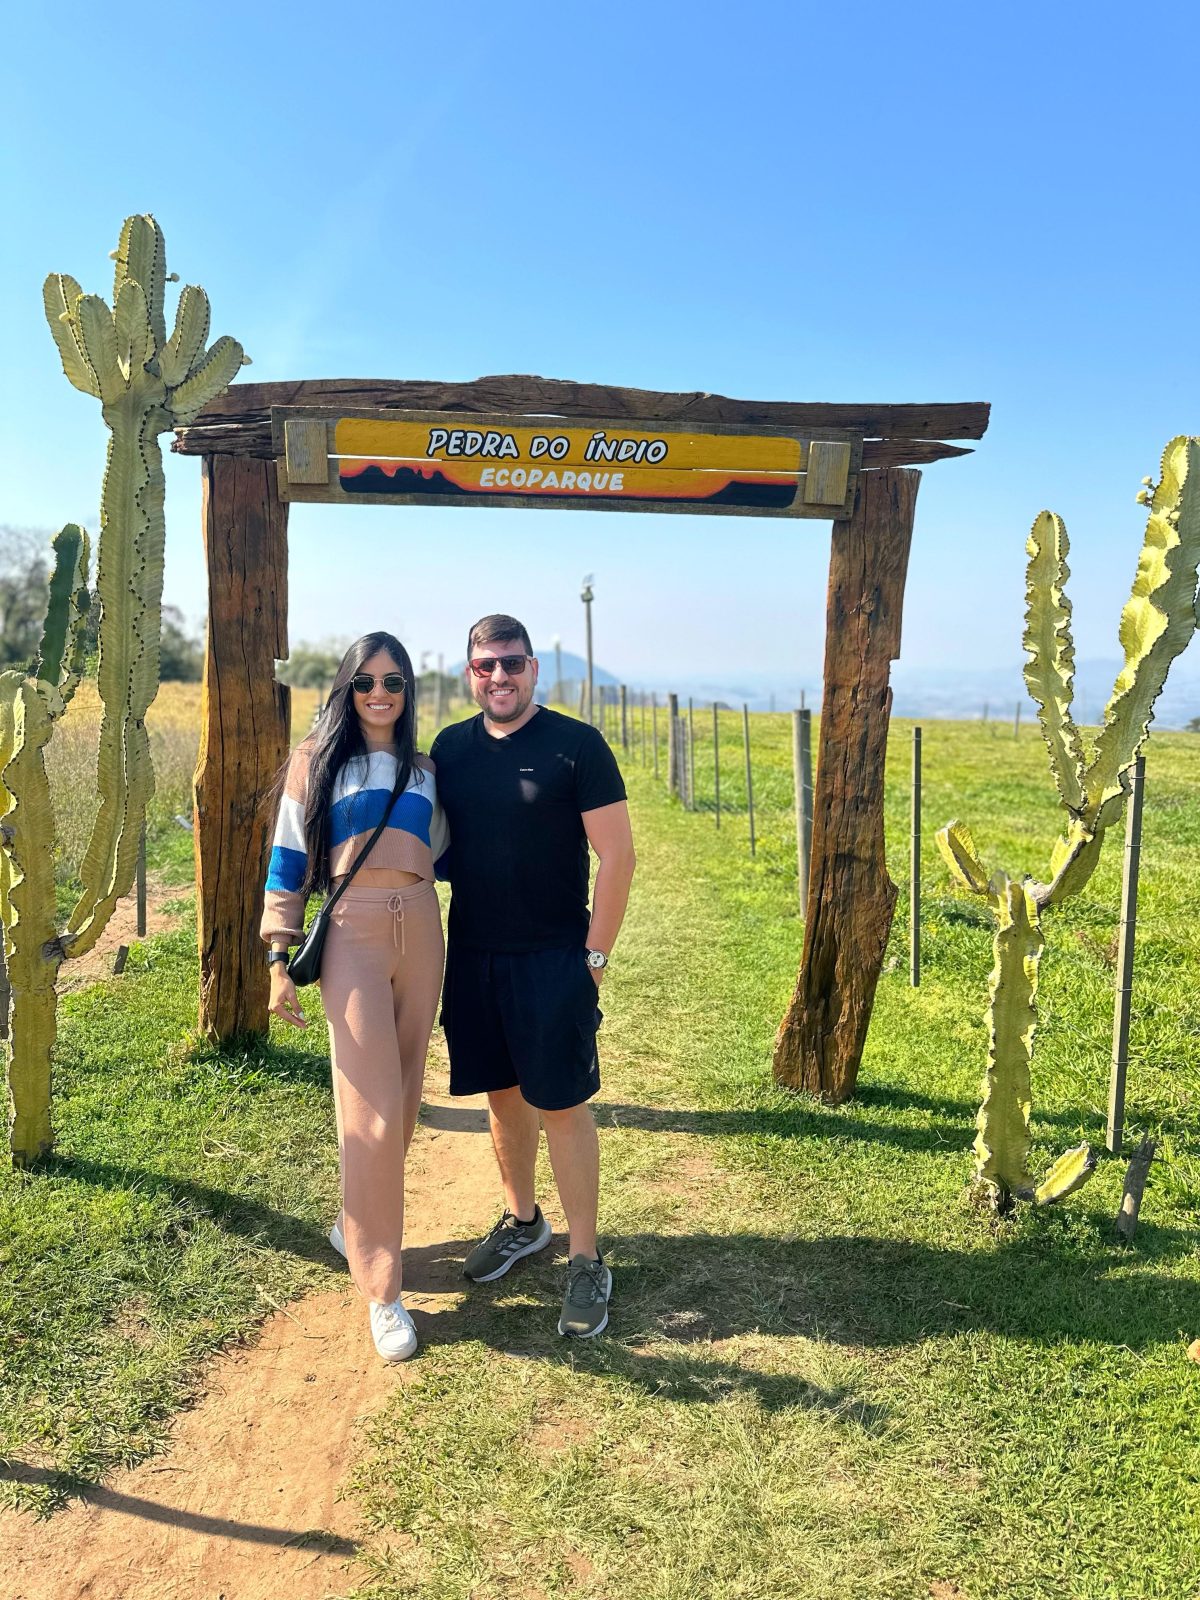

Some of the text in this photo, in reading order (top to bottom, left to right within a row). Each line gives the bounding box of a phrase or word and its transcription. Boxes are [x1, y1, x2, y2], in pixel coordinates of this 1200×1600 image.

[427, 428, 668, 463] PEDRA DO ÍNDIO
[479, 467, 624, 491] ECOPARQUE
